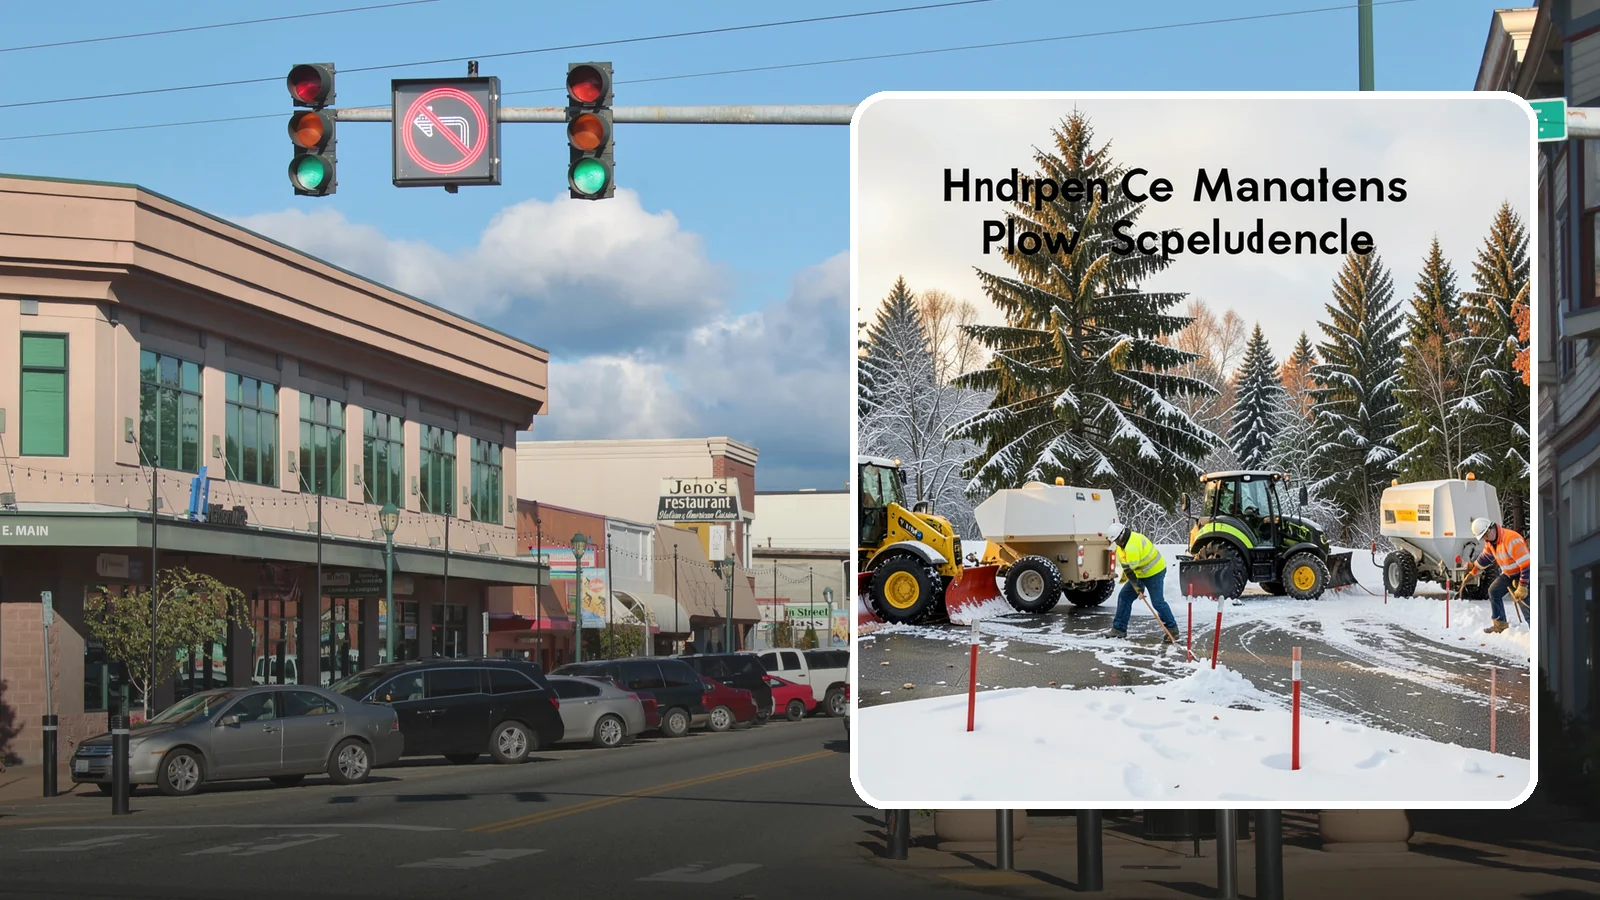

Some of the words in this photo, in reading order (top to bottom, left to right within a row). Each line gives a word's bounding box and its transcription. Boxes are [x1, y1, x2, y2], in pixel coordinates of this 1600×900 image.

[670, 480, 727, 494] Jeno's
[665, 496, 731, 509] restaurant
[658, 509, 681, 519] Italian
[686, 509, 714, 519] American
[714, 509, 738, 519] Cuisine
[2, 525, 13, 536] E.
[15, 525, 49, 536] MAIN
[797, 607, 828, 616] Street
[791, 619, 824, 627] lass
